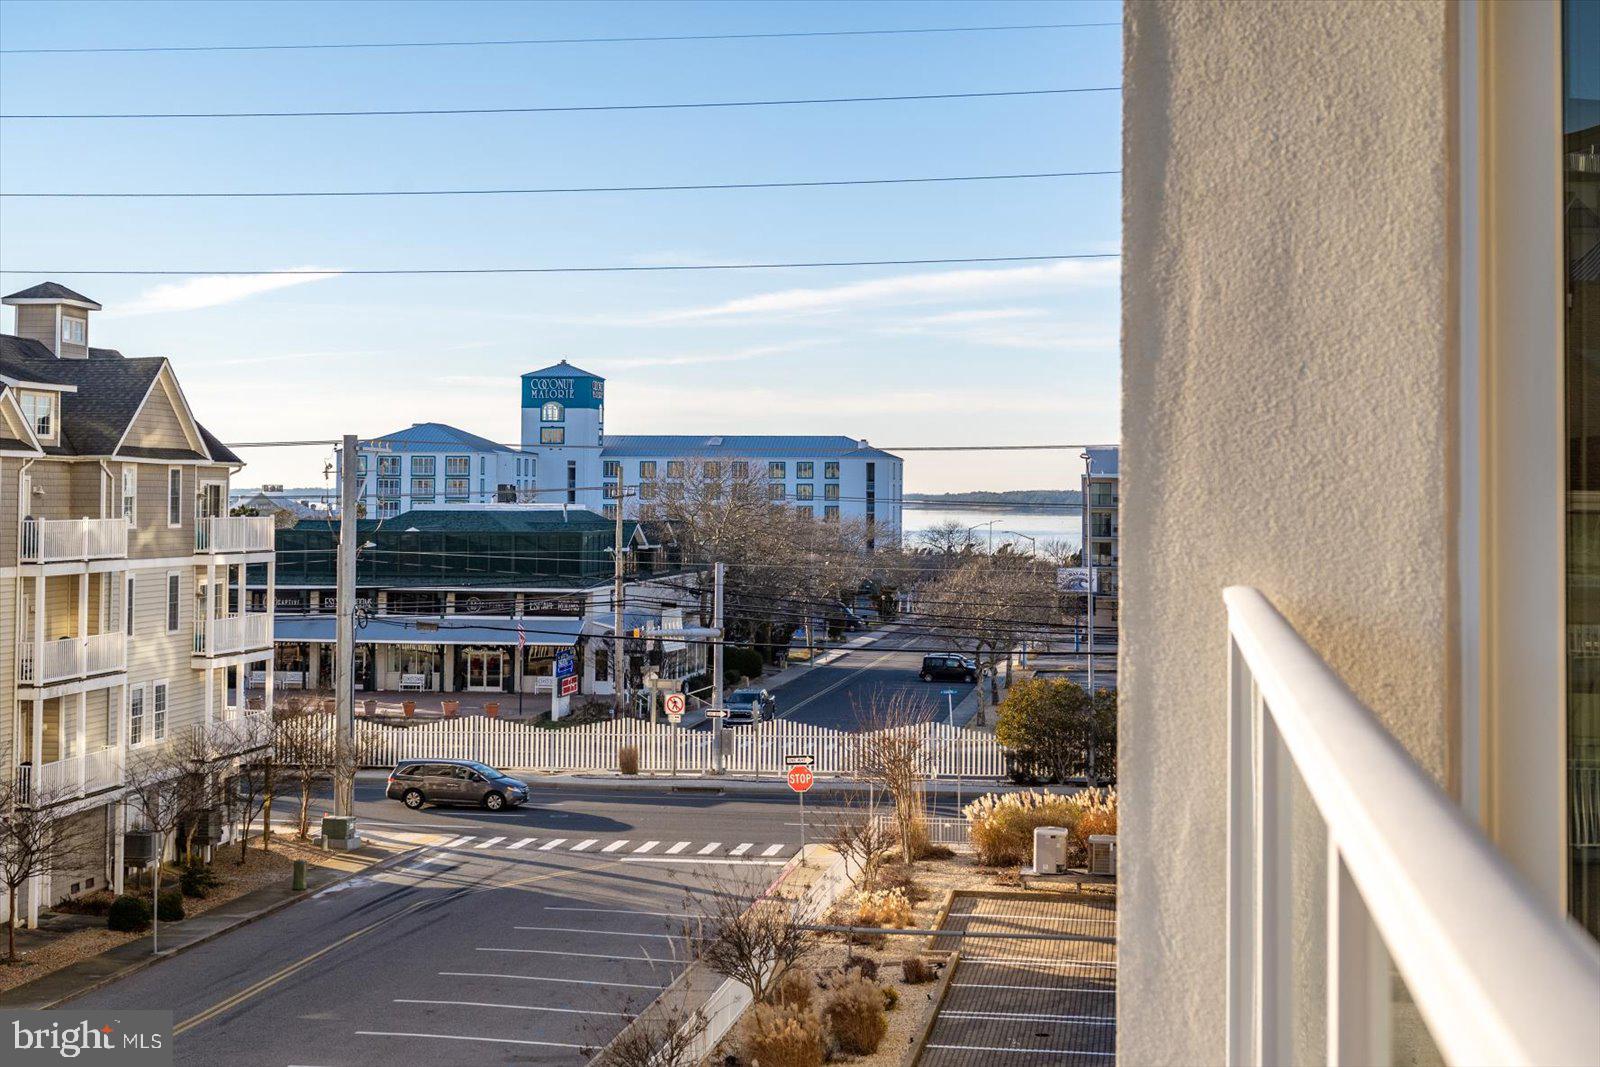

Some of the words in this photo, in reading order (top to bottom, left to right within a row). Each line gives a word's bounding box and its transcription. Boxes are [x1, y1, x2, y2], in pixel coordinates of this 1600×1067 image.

[530, 378, 575, 390] COCONUT
[531, 390, 575, 399] MALORIE
[789, 773, 812, 784] STOP
